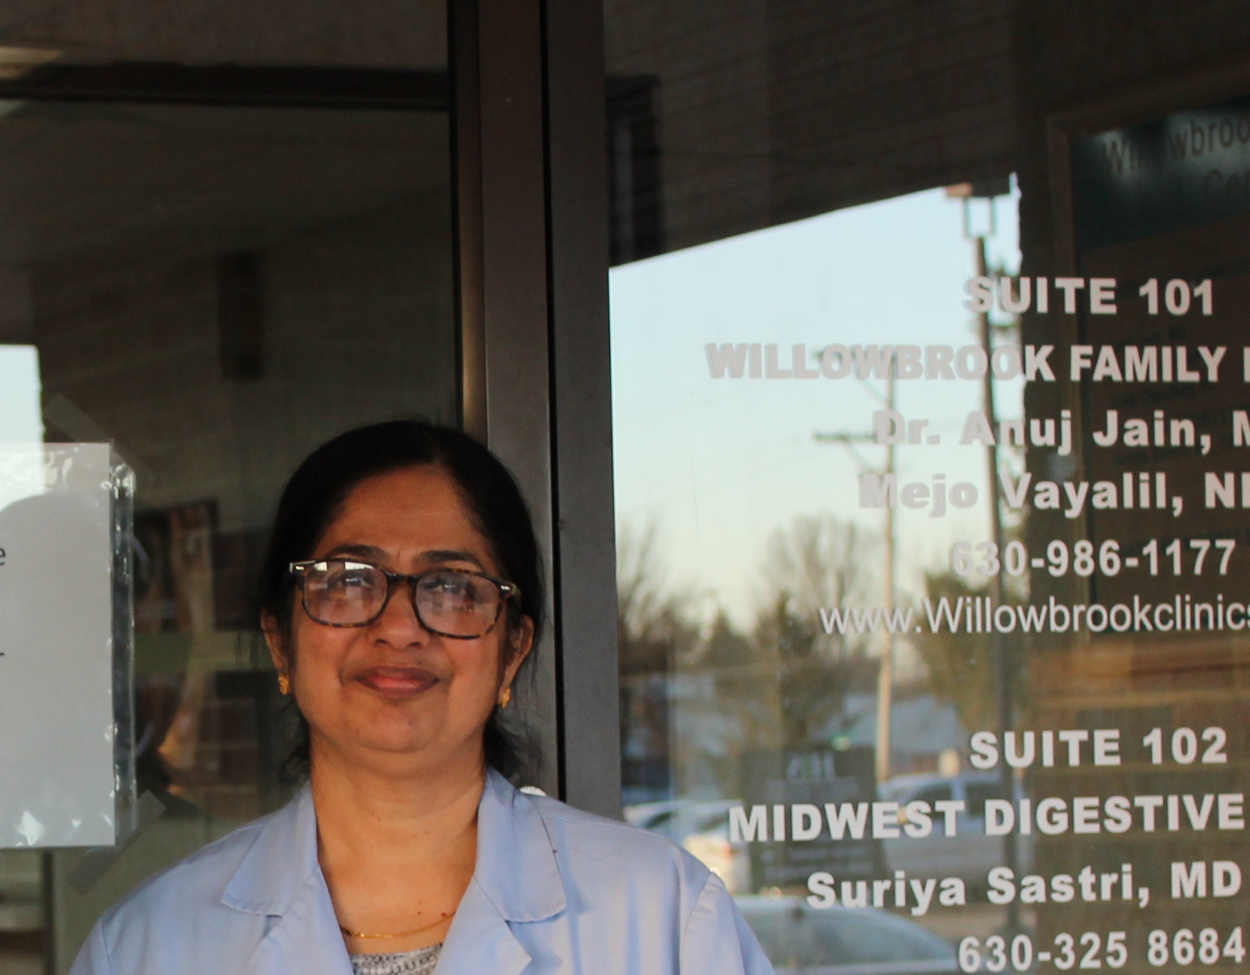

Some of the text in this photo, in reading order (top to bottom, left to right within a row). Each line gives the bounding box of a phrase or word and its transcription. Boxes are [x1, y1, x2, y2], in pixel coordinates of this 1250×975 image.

[964, 276, 1214, 315] SUITE 101
[705, 342, 1054, 382] WILLOWBROOK
[1070, 345, 1227, 382] FAMILY
[874, 409, 940, 446] Dr.
[959, 410, 1073, 455] Anuj
[1093, 410, 1211, 455] Jain,
[858, 473, 979, 517] Mejo
[998, 472, 1184, 518] Vayalil,
[949, 539, 1237, 577] 630-986-1177
[819, 594, 1250, 634] www.Willowbrookclinic
[969, 727, 1228, 770] SUITE 102
[728, 793, 1246, 842] MIDWEST DIGESTIVE
[807, 861, 1242, 915] Suriya Sastri, MD
[958, 927, 1246, 973] 630-325 8684
